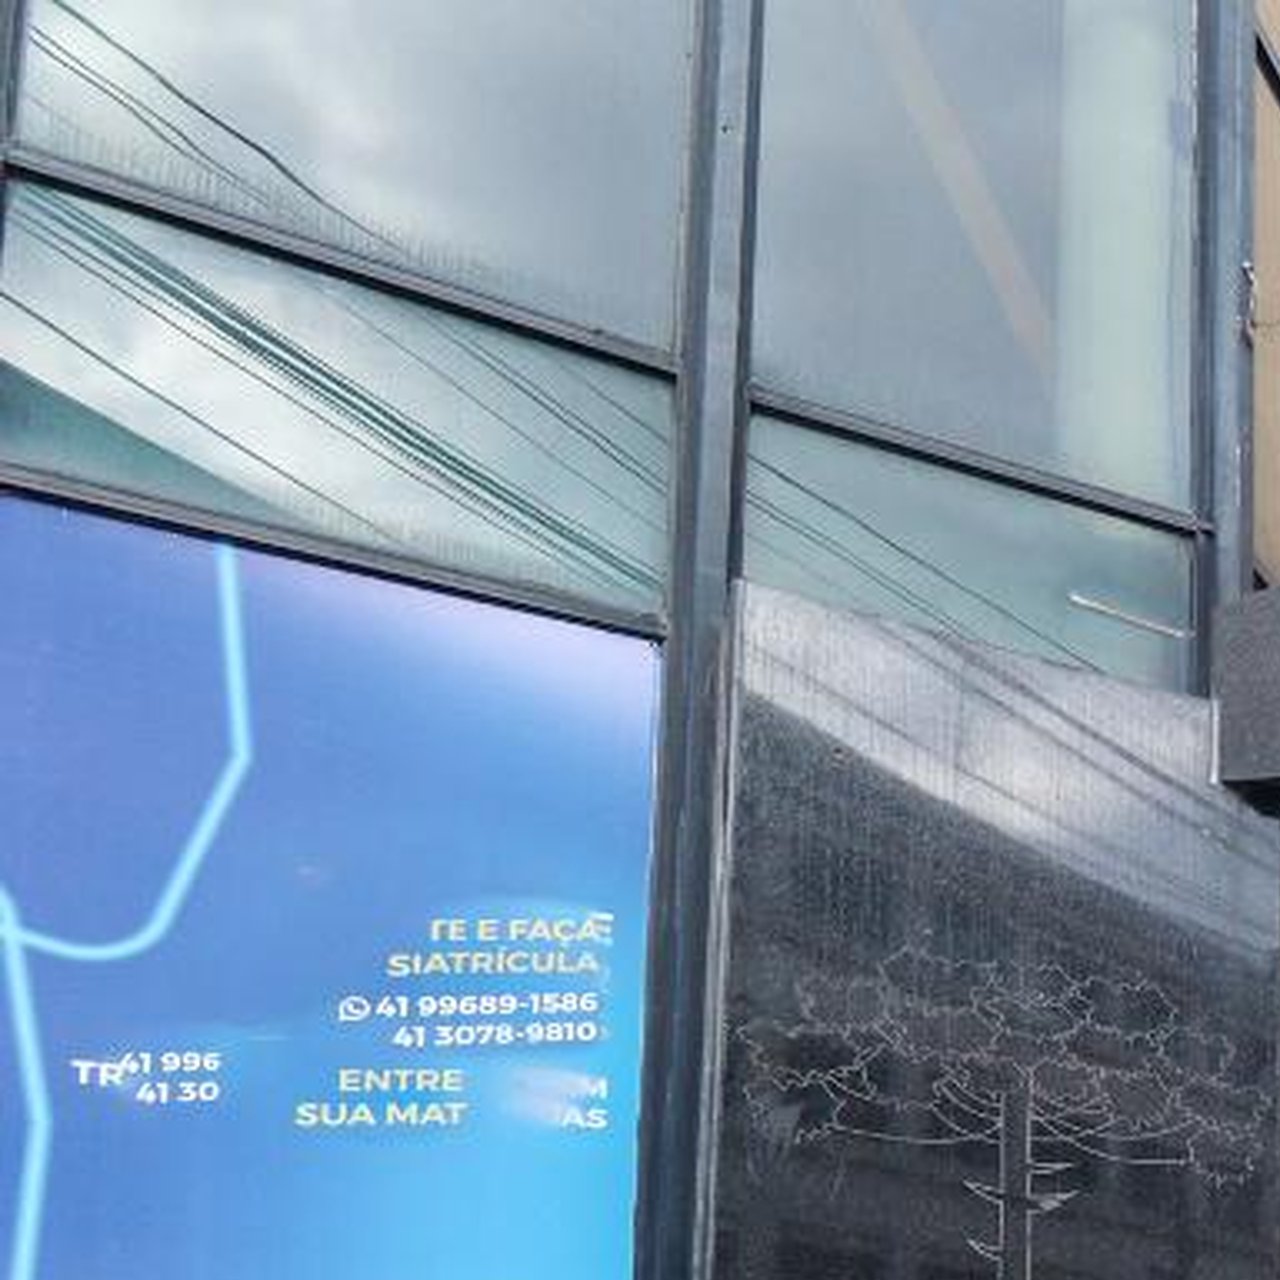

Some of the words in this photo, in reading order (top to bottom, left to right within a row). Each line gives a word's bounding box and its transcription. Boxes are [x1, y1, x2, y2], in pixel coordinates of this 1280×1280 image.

[376, 995, 409, 1018] 41
[418, 992, 598, 1016] 99689-1586
[393, 1025, 426, 1047] 41
[434, 1022, 598, 1045] 3078-9810
[121, 1051, 152, 1075] 41
[160, 1051, 222, 1072] 996
[338, 1068, 465, 1092] ENTRE
[136, 1082, 169, 1104] 41
[177, 1081, 220, 1102] 30
[294, 1102, 375, 1126] SUA
[384, 1102, 469, 1125] MAT
